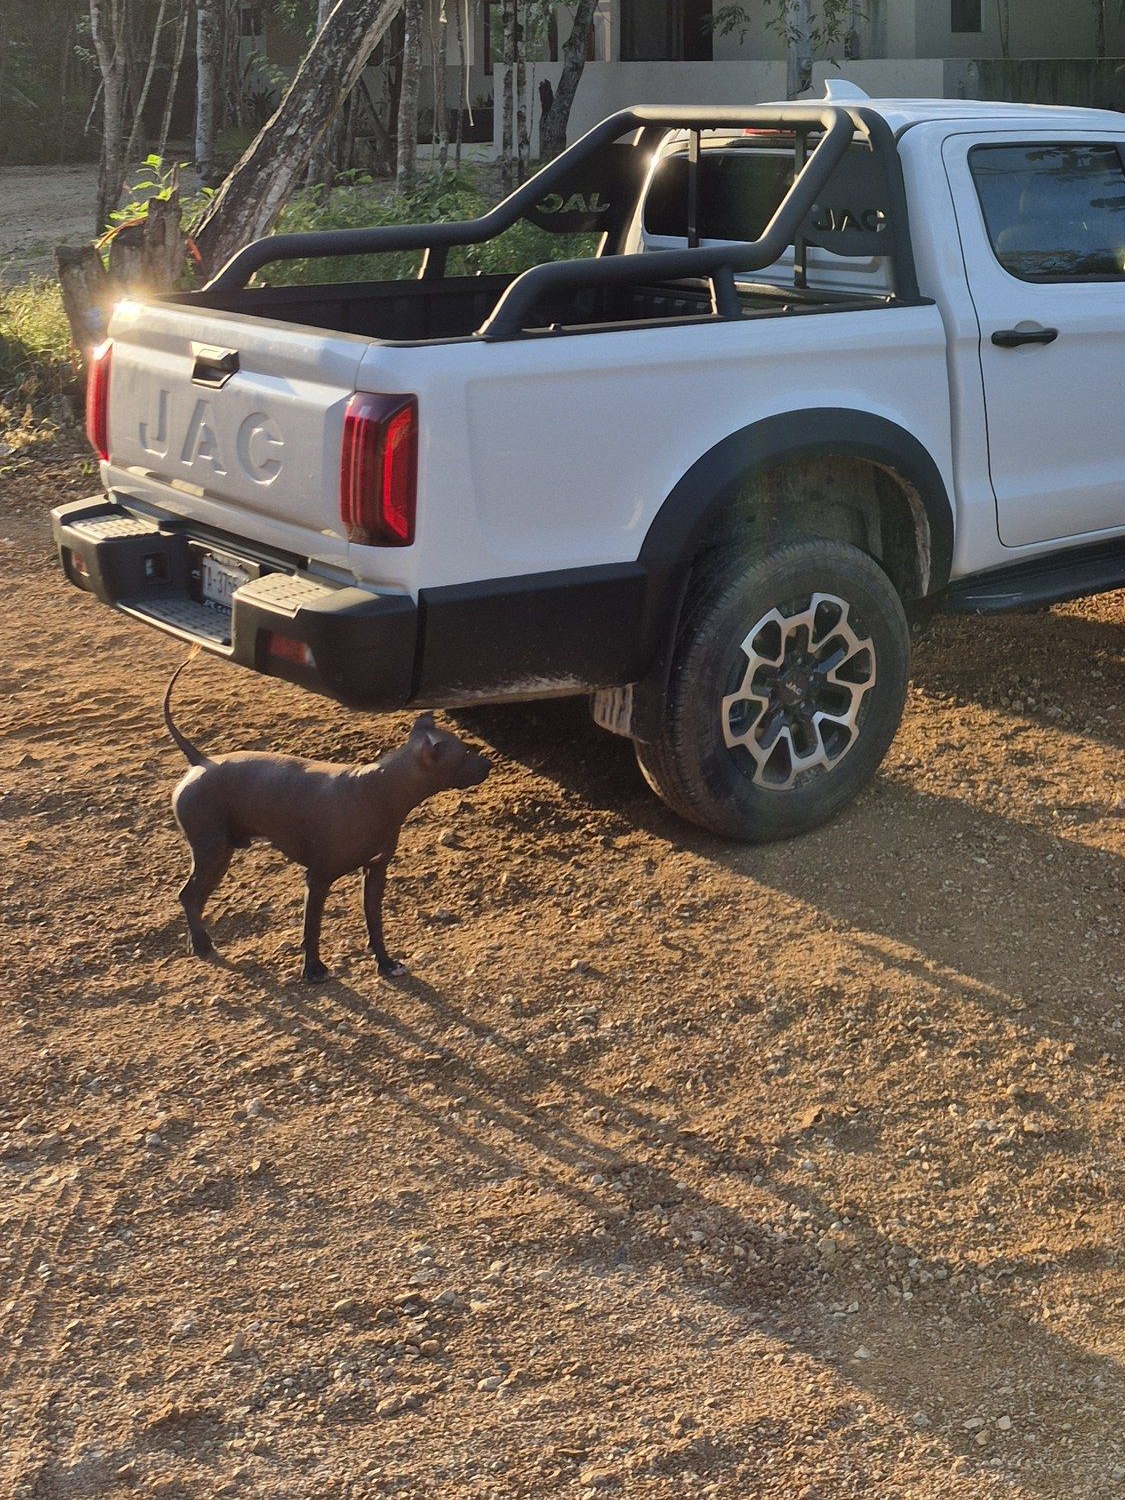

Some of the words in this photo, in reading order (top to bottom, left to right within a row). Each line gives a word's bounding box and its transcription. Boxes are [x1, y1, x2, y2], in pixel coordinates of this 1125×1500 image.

[811, 207, 888, 233] JAC
[138, 389, 286, 488] JAC
[785, 681, 803, 696] JAC
